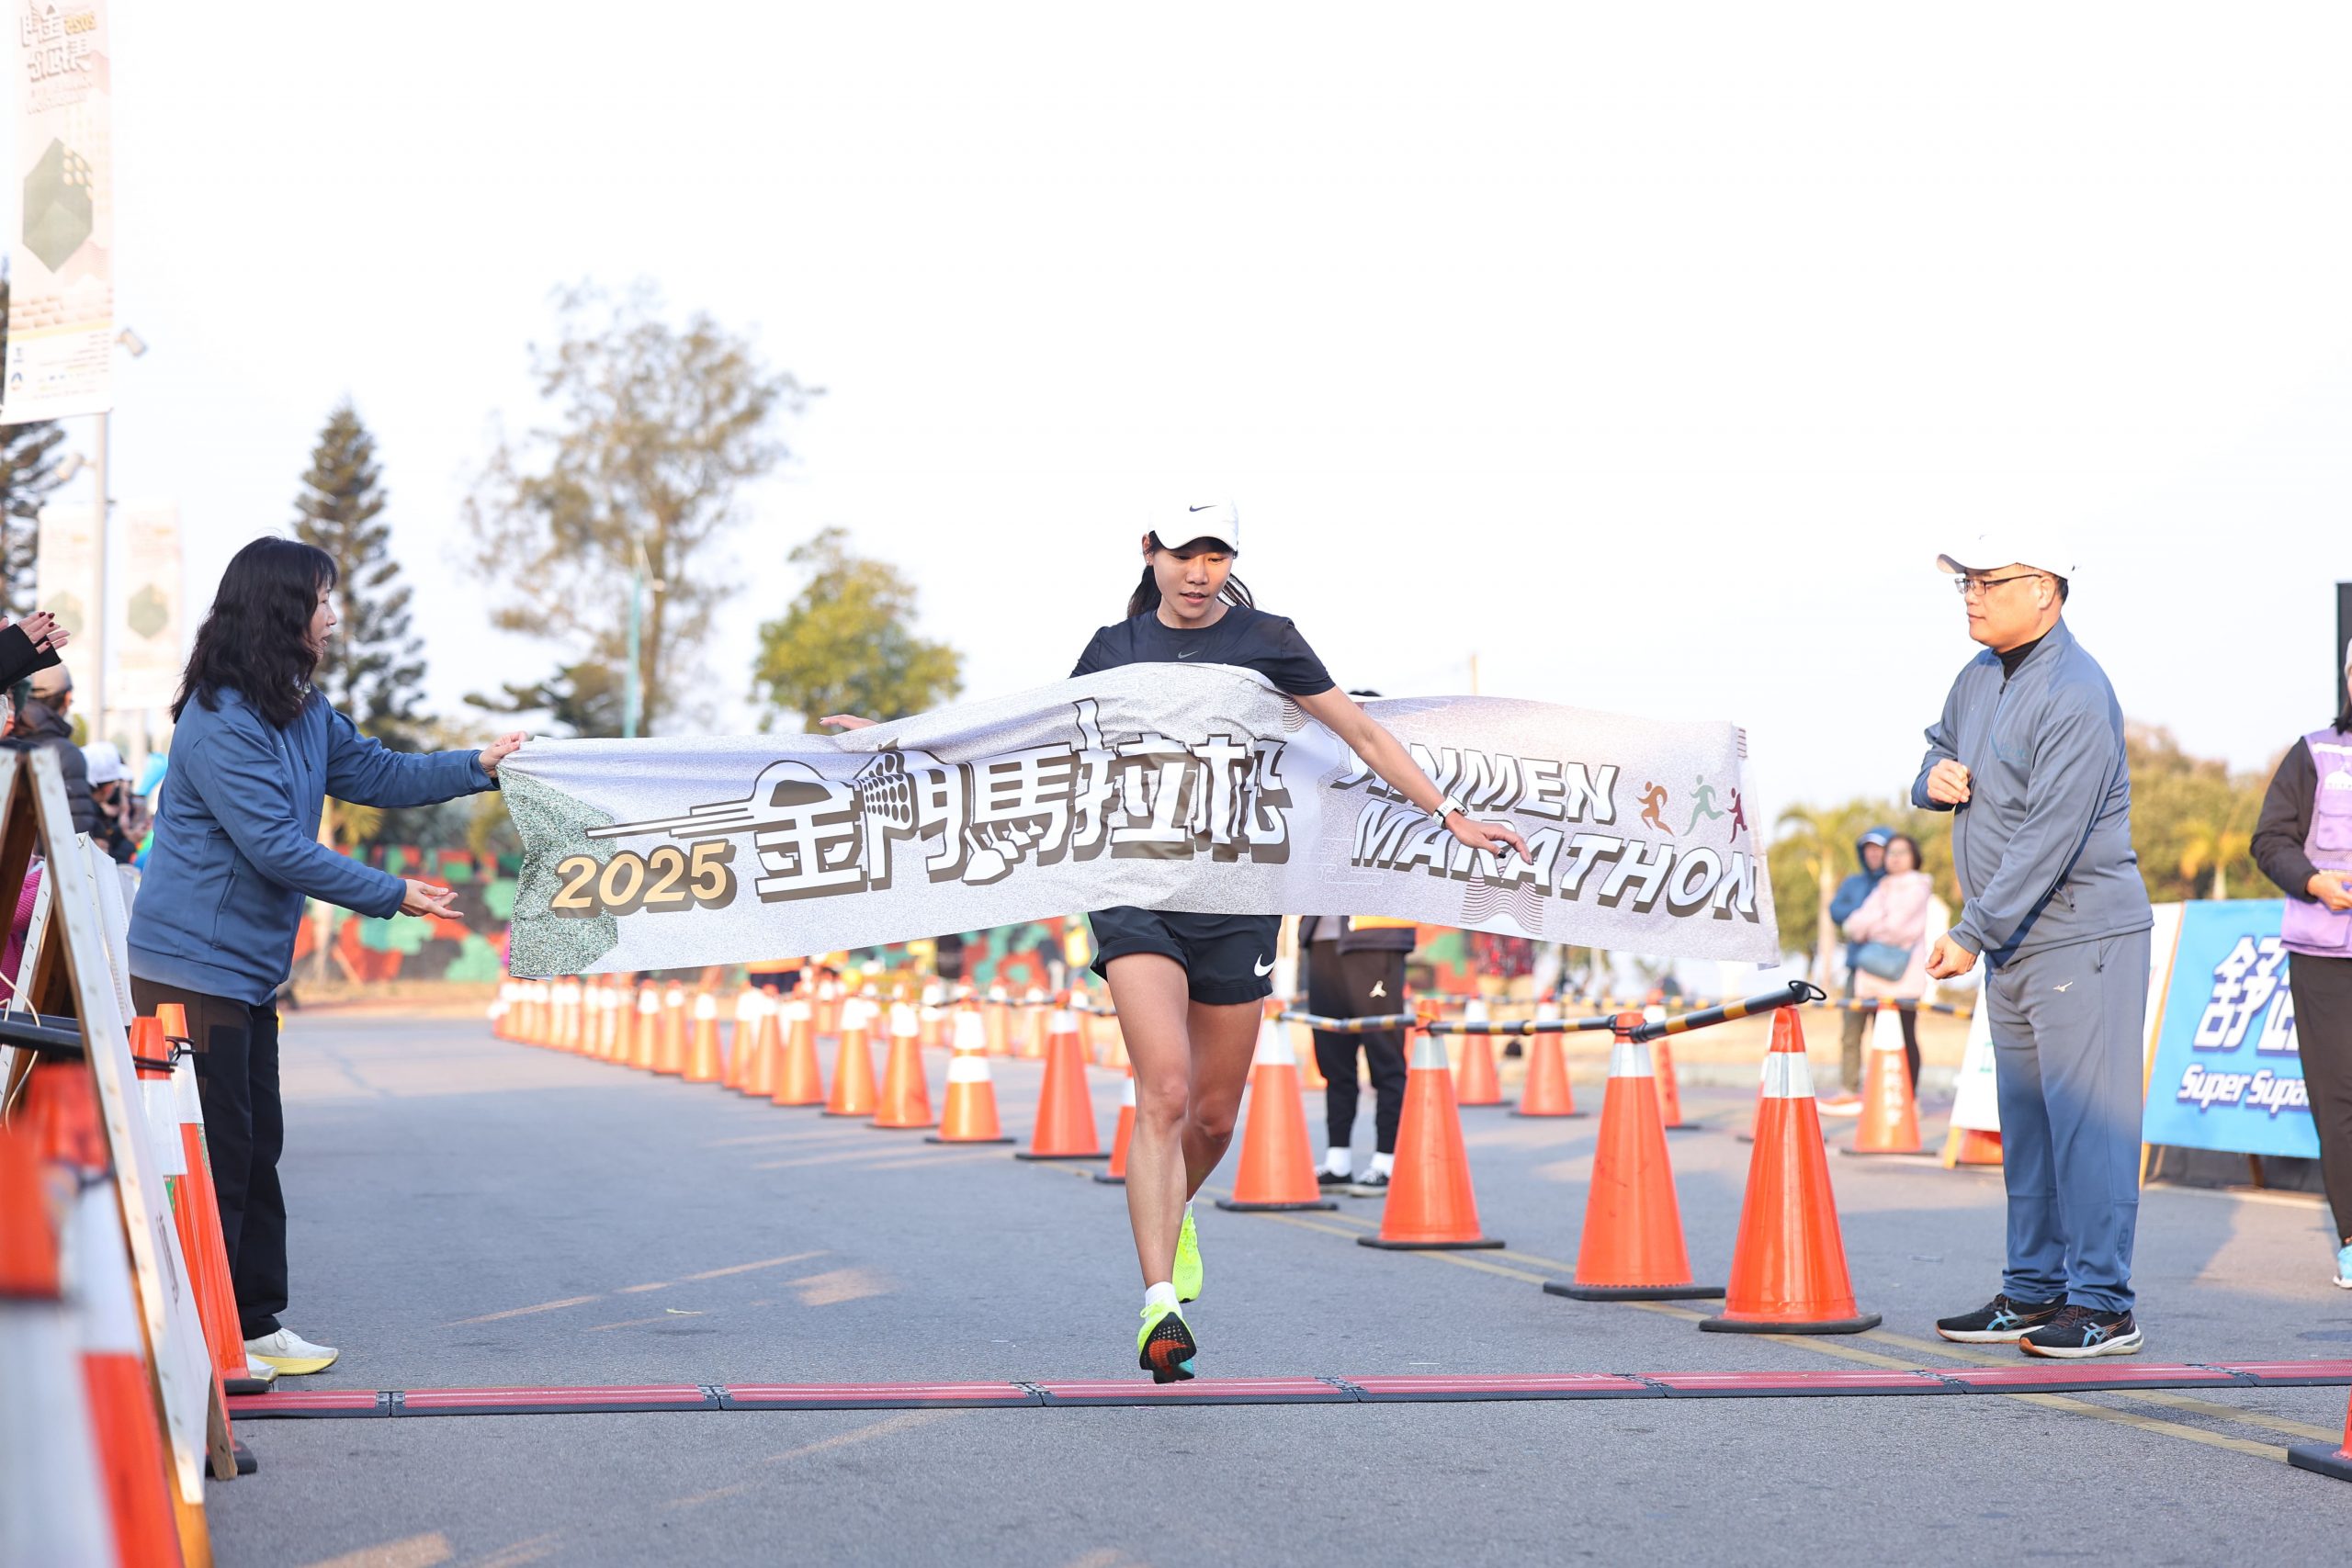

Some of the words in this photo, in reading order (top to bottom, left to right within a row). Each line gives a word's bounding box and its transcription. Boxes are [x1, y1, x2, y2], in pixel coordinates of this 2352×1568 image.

[753, 697, 1293, 902] 金門馬拉松
[1330, 742, 1620, 825] NMEN
[551, 839, 737, 919] 2025
[2177, 1063, 2252, 1113] Super
